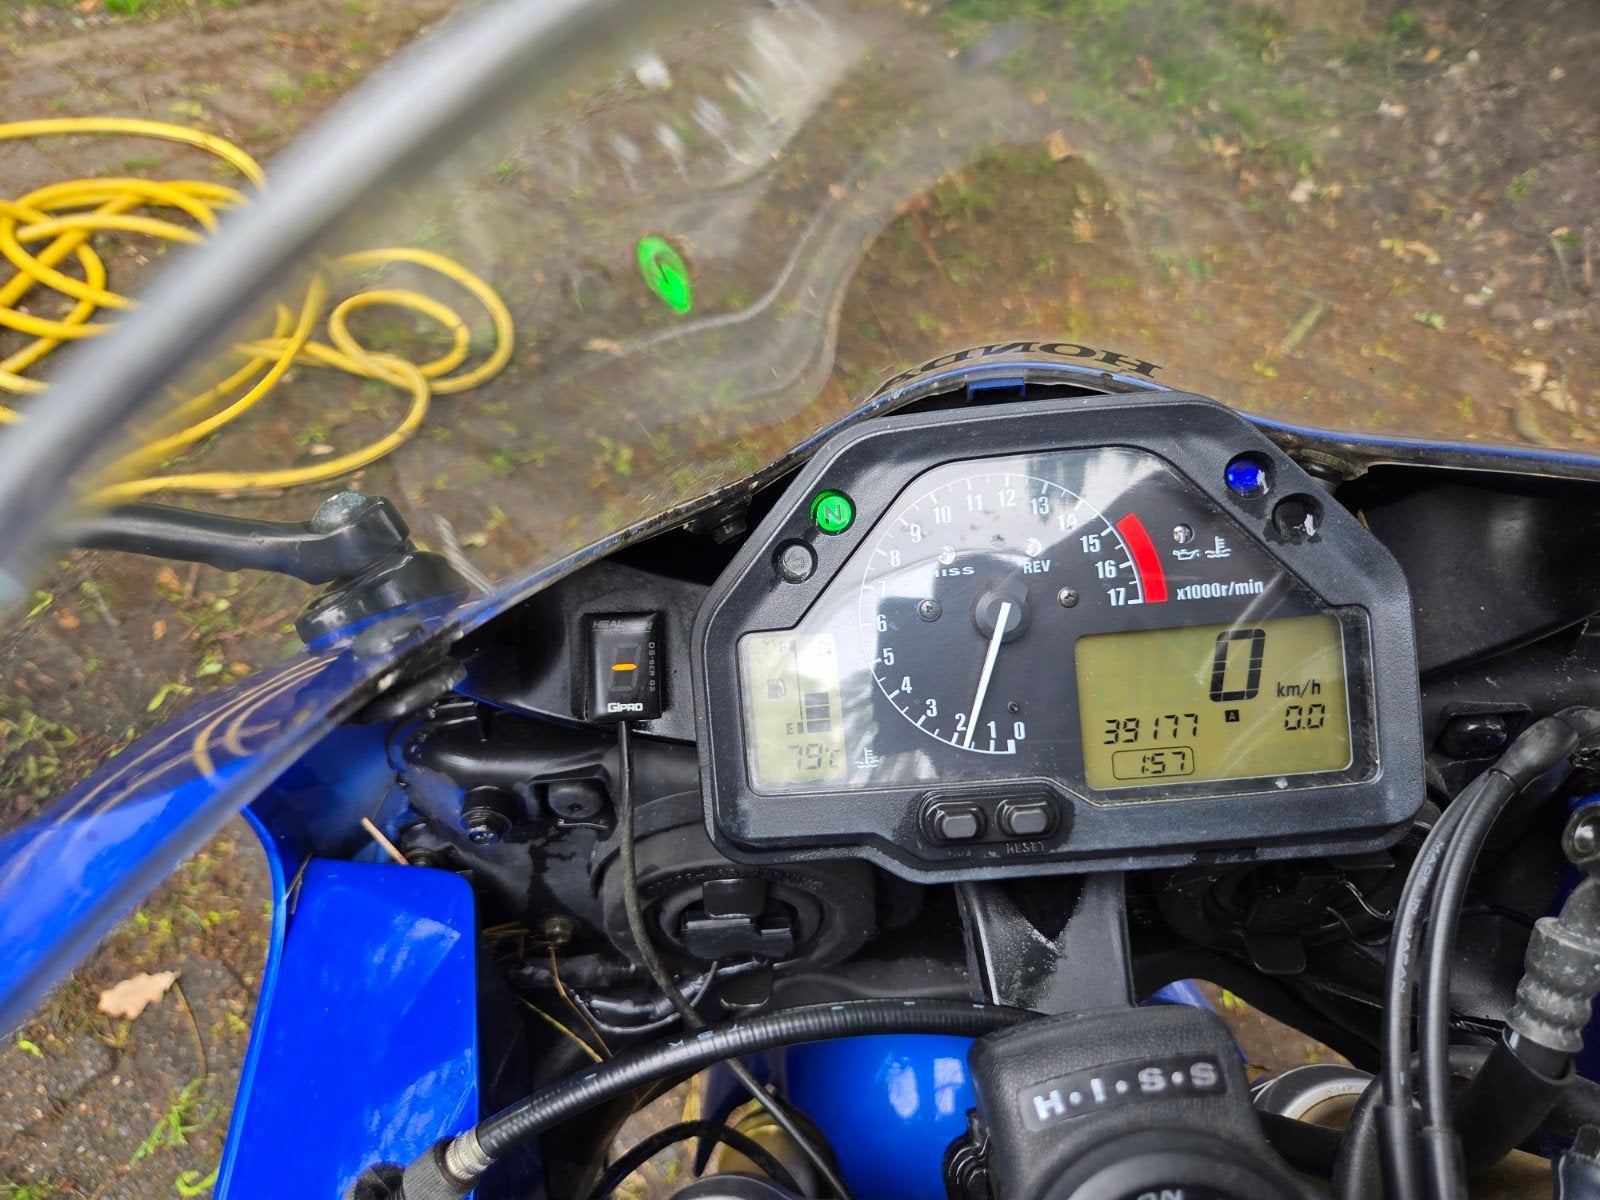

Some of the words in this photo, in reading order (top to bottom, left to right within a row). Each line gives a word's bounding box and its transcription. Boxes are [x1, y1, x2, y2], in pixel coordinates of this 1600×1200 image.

[966, 493, 984, 511] 11
[998, 489, 1016, 507] 12
[1030, 497, 1049, 515] 13
[824, 504, 842, 524] N
[933, 506, 952, 523] 10
[1057, 513, 1078, 531] 14
[910, 524, 922, 542] 9
[1080, 535, 1100, 553] 15
[890, 549, 900, 567] 8
[1023, 560, 1051, 574] REV
[929, 566, 975, 578] HISS
[1095, 561, 1116, 579] 16
[1107, 588, 1127, 606] 17
[1176, 579, 1264, 600] x1000r/min
[876, 615, 888, 632] 6
[883, 648, 895, 666] 5
[1209, 628, 1266, 702] 0
[901, 677, 912, 694] 4
[1276, 679, 1321, 698] km/h
[925, 699, 938, 717] 3
[1284, 703, 1326, 731] 0.0
[786, 722, 794, 735] E
[954, 713, 966, 732] 2
[986, 721, 997, 738] 1
[1014, 721, 1025, 740] 0
[1103, 713, 1198, 745] 39177
[1141, 751, 1186, 774] 1:57
[1418, 841, 1445, 886] MADE
[1411, 898, 1422, 914] IN
[1399, 928, 1412, 993] JAPAN
